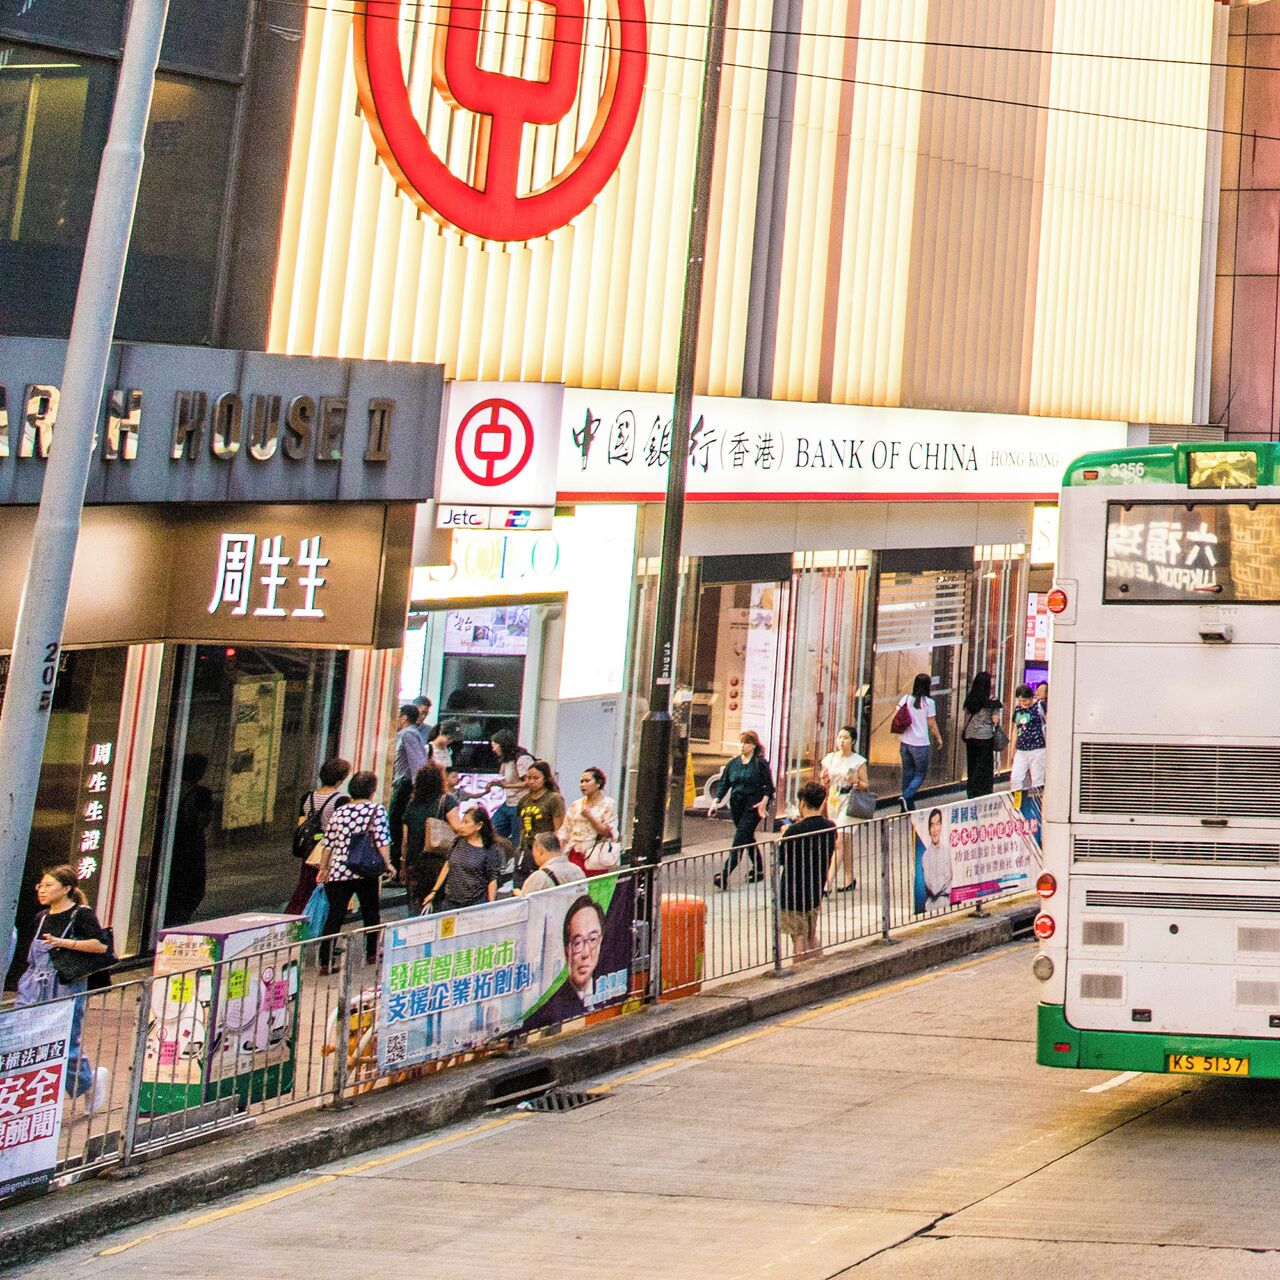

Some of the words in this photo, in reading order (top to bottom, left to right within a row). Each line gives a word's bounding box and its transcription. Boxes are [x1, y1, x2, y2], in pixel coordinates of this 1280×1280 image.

[169, 390, 349, 462] HOUSE
[795, 436, 862, 470] BANK
[871, 438, 901, 471] OF
[908, 440, 979, 472] CHINA
[207, 531, 331, 619] 周生生
[77, 742, 112, 881] 周生生證券
[387, 962, 533, 1024] 支援企業拓創科
[390, 941, 517, 992] 發展智慧城市
[1173, 1055, 1195, 1070] KS
[1203, 1056, 1244, 1072] 5137
[0, 1069, 59, 1116] 安全
